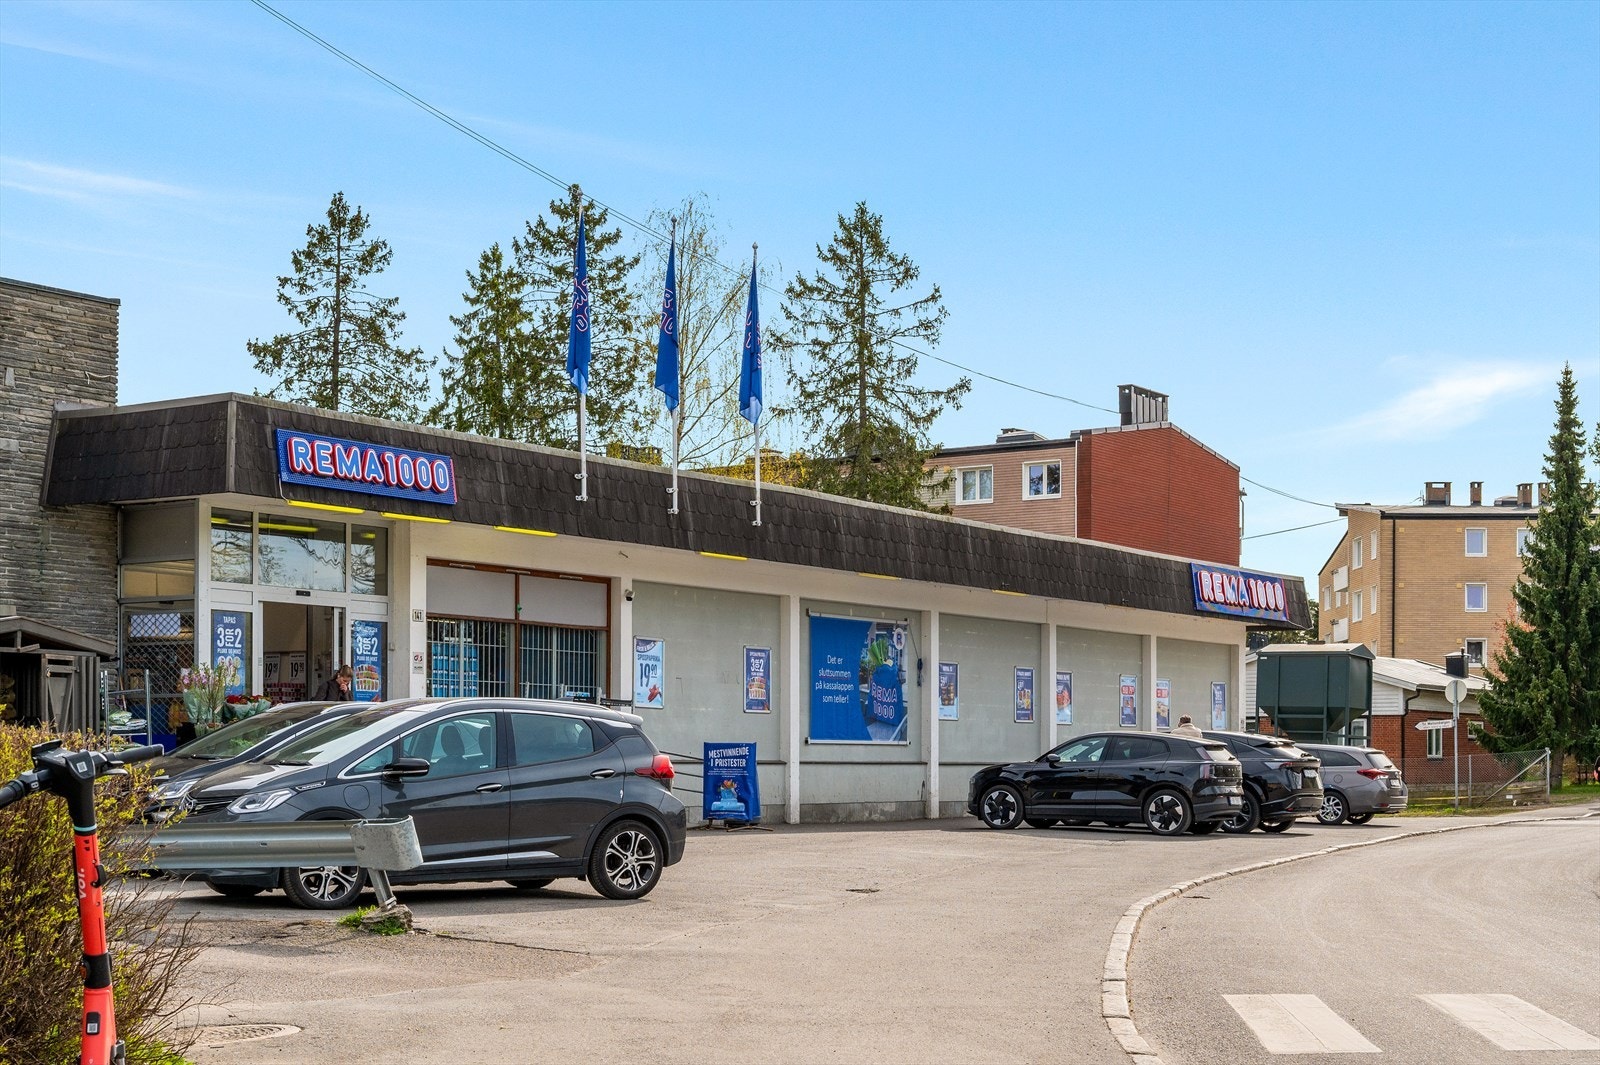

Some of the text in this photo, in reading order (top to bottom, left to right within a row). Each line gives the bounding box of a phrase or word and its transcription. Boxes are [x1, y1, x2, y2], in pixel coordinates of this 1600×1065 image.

[223, 616, 237, 624] TAPAS
[414, 611, 422, 620] 141
[217, 627, 242, 648] 3 FOR 2
[356, 636, 378, 656] 3 FOR 2
[750, 658, 755, 672] 3
[760, 658, 764, 672] 2
[827, 655, 843, 665] Det er
[265, 662, 273, 678] 19
[291, 662, 299, 678] 19
[640, 663, 658, 687] 19 90
[818, 668, 852, 678] sluttsummen
[815, 681, 855, 692] på kassalappen
[871, 682, 898, 703] REMA
[833, 695, 849, 704] teller!
[873, 701, 895, 719] 1000
[708, 747, 750, 759] MESTVINNENDE
[715, 758, 747, 767] PRISTESTER
